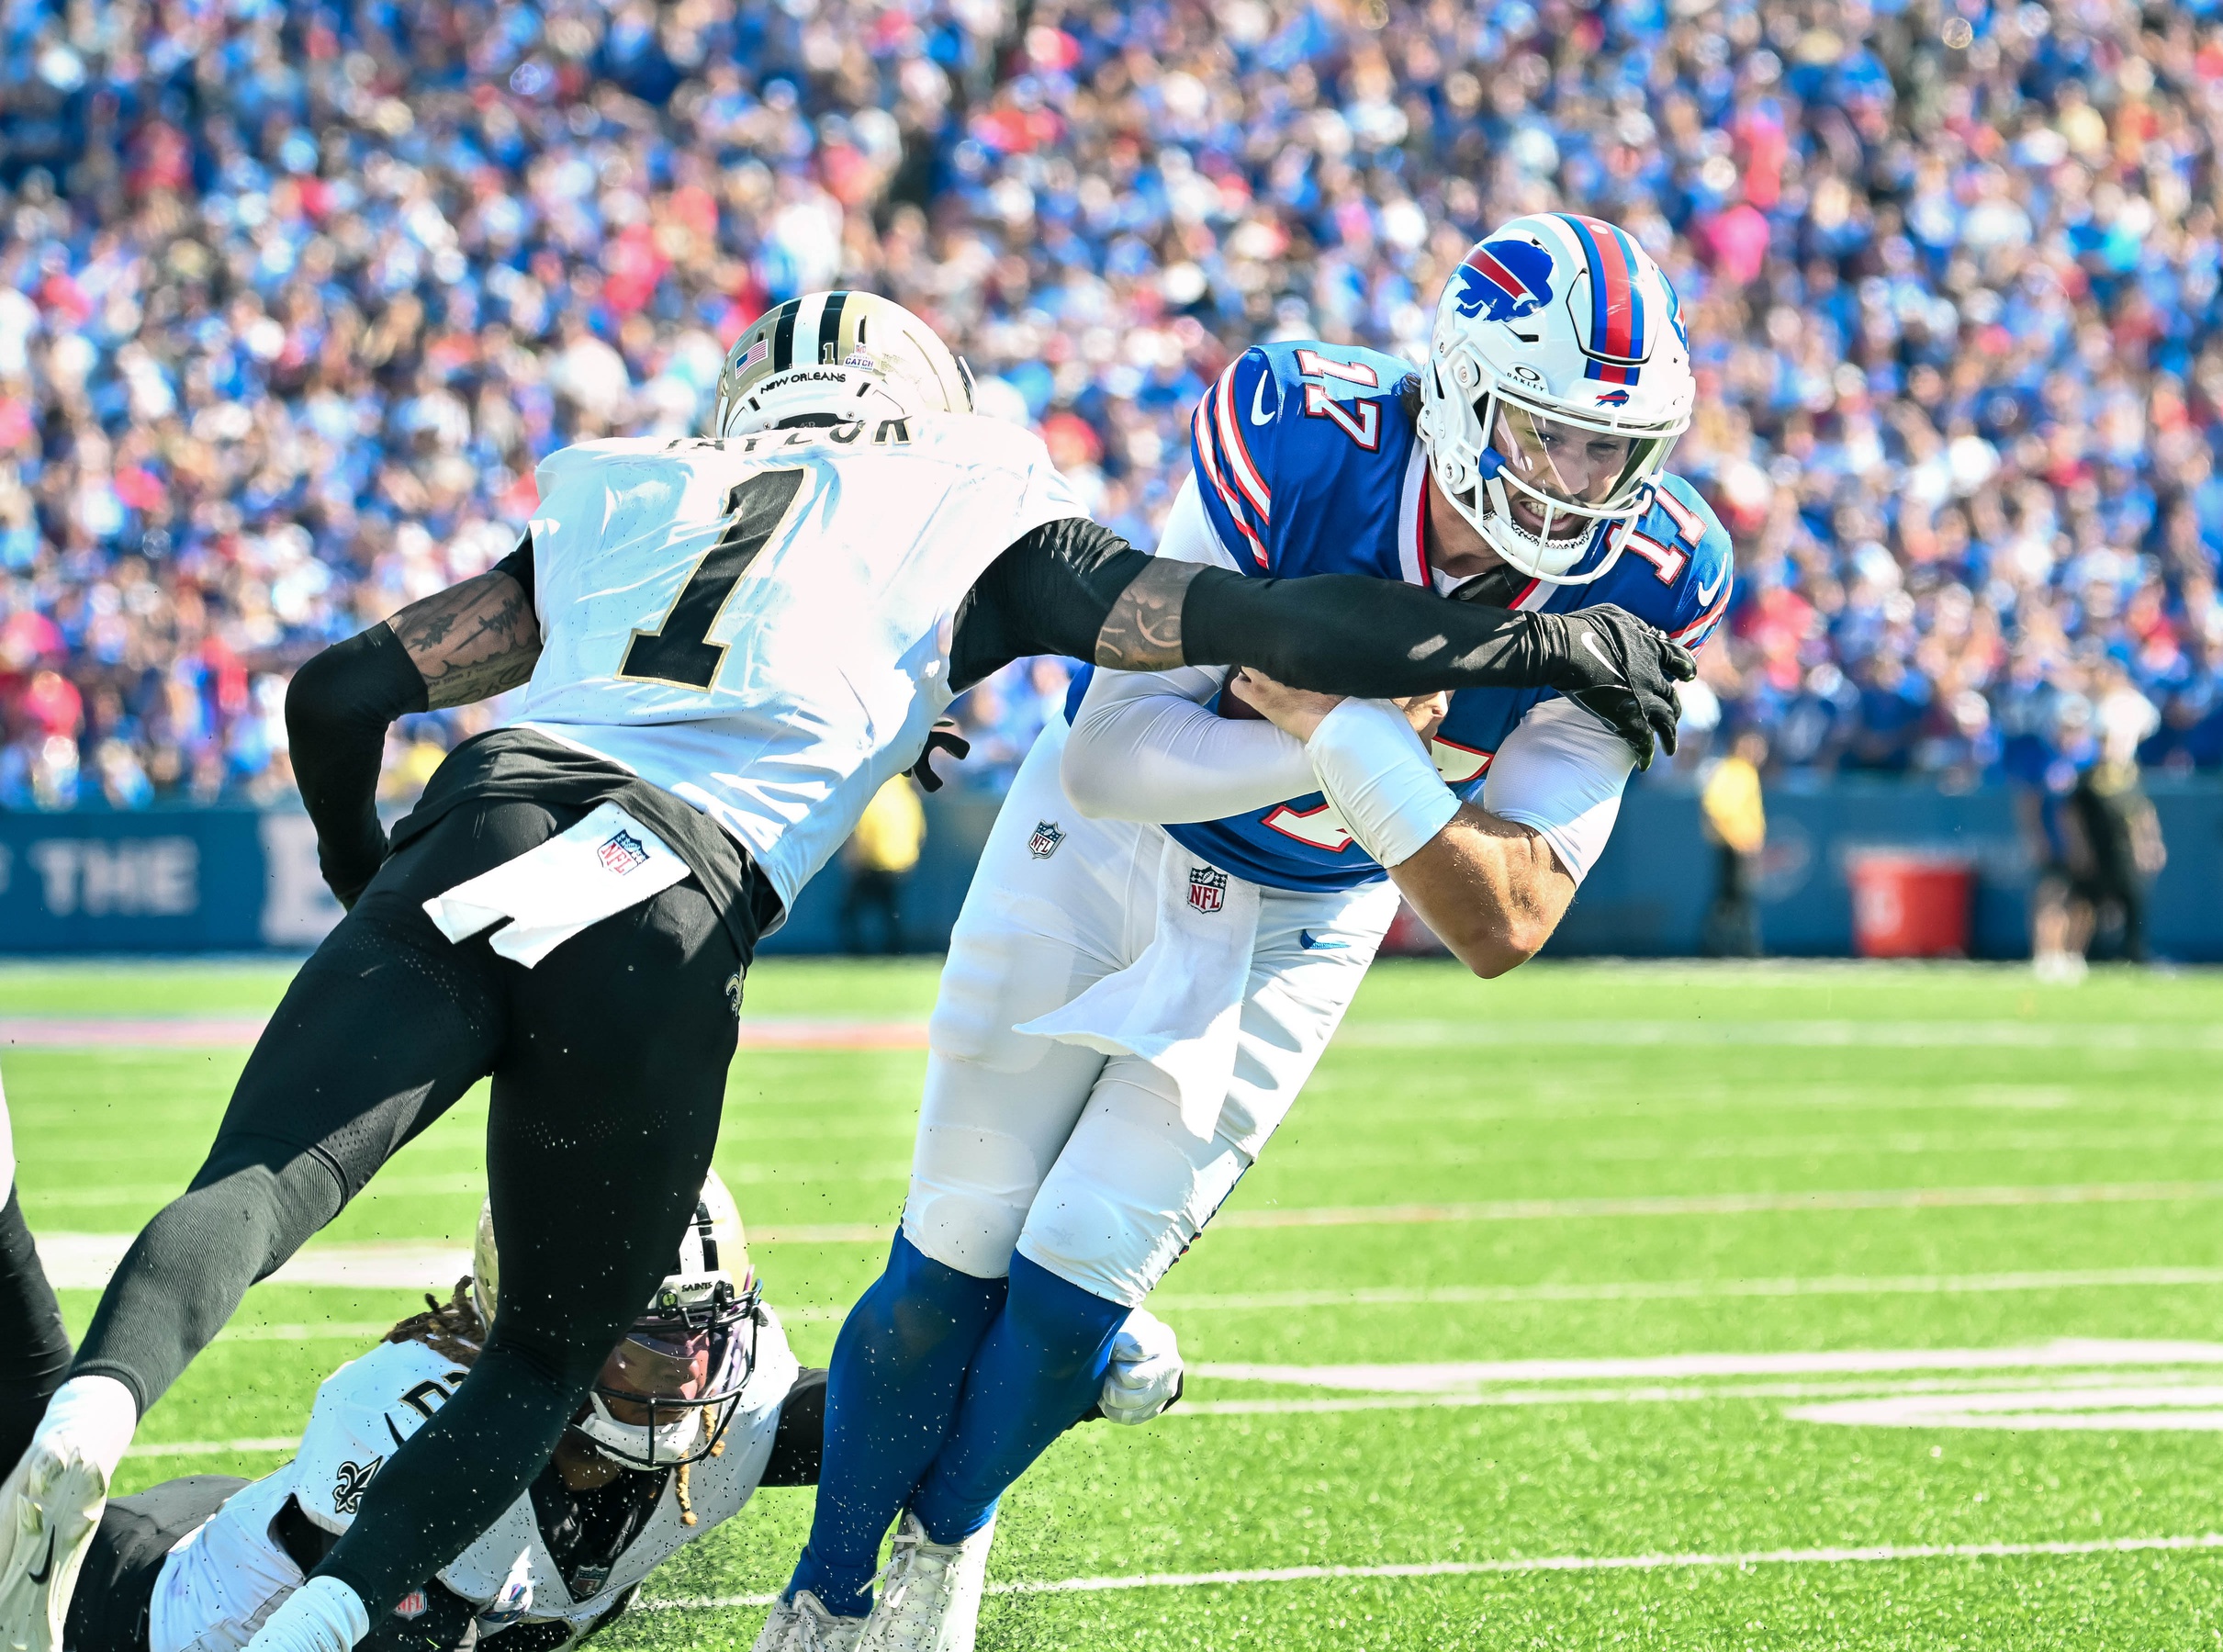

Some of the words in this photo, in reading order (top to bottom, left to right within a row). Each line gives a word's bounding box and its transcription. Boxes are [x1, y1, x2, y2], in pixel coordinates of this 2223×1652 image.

[823, 342, 836, 365] 1
[845, 357, 874, 367] CATCH
[760, 376, 789, 394] NEW
[791, 372, 846, 382] ORLEANS
[1507, 372, 1544, 391] OAKLEY
[1295, 349, 1381, 451] 17
[613, 465, 809, 693] 1
[1030, 833, 1051, 853] NFL
[601, 842, 632, 873] NFL
[28, 837, 201, 917] THE
[1189, 883, 1220, 910] NFL
[681, 1281, 713, 1292] SAINTS
